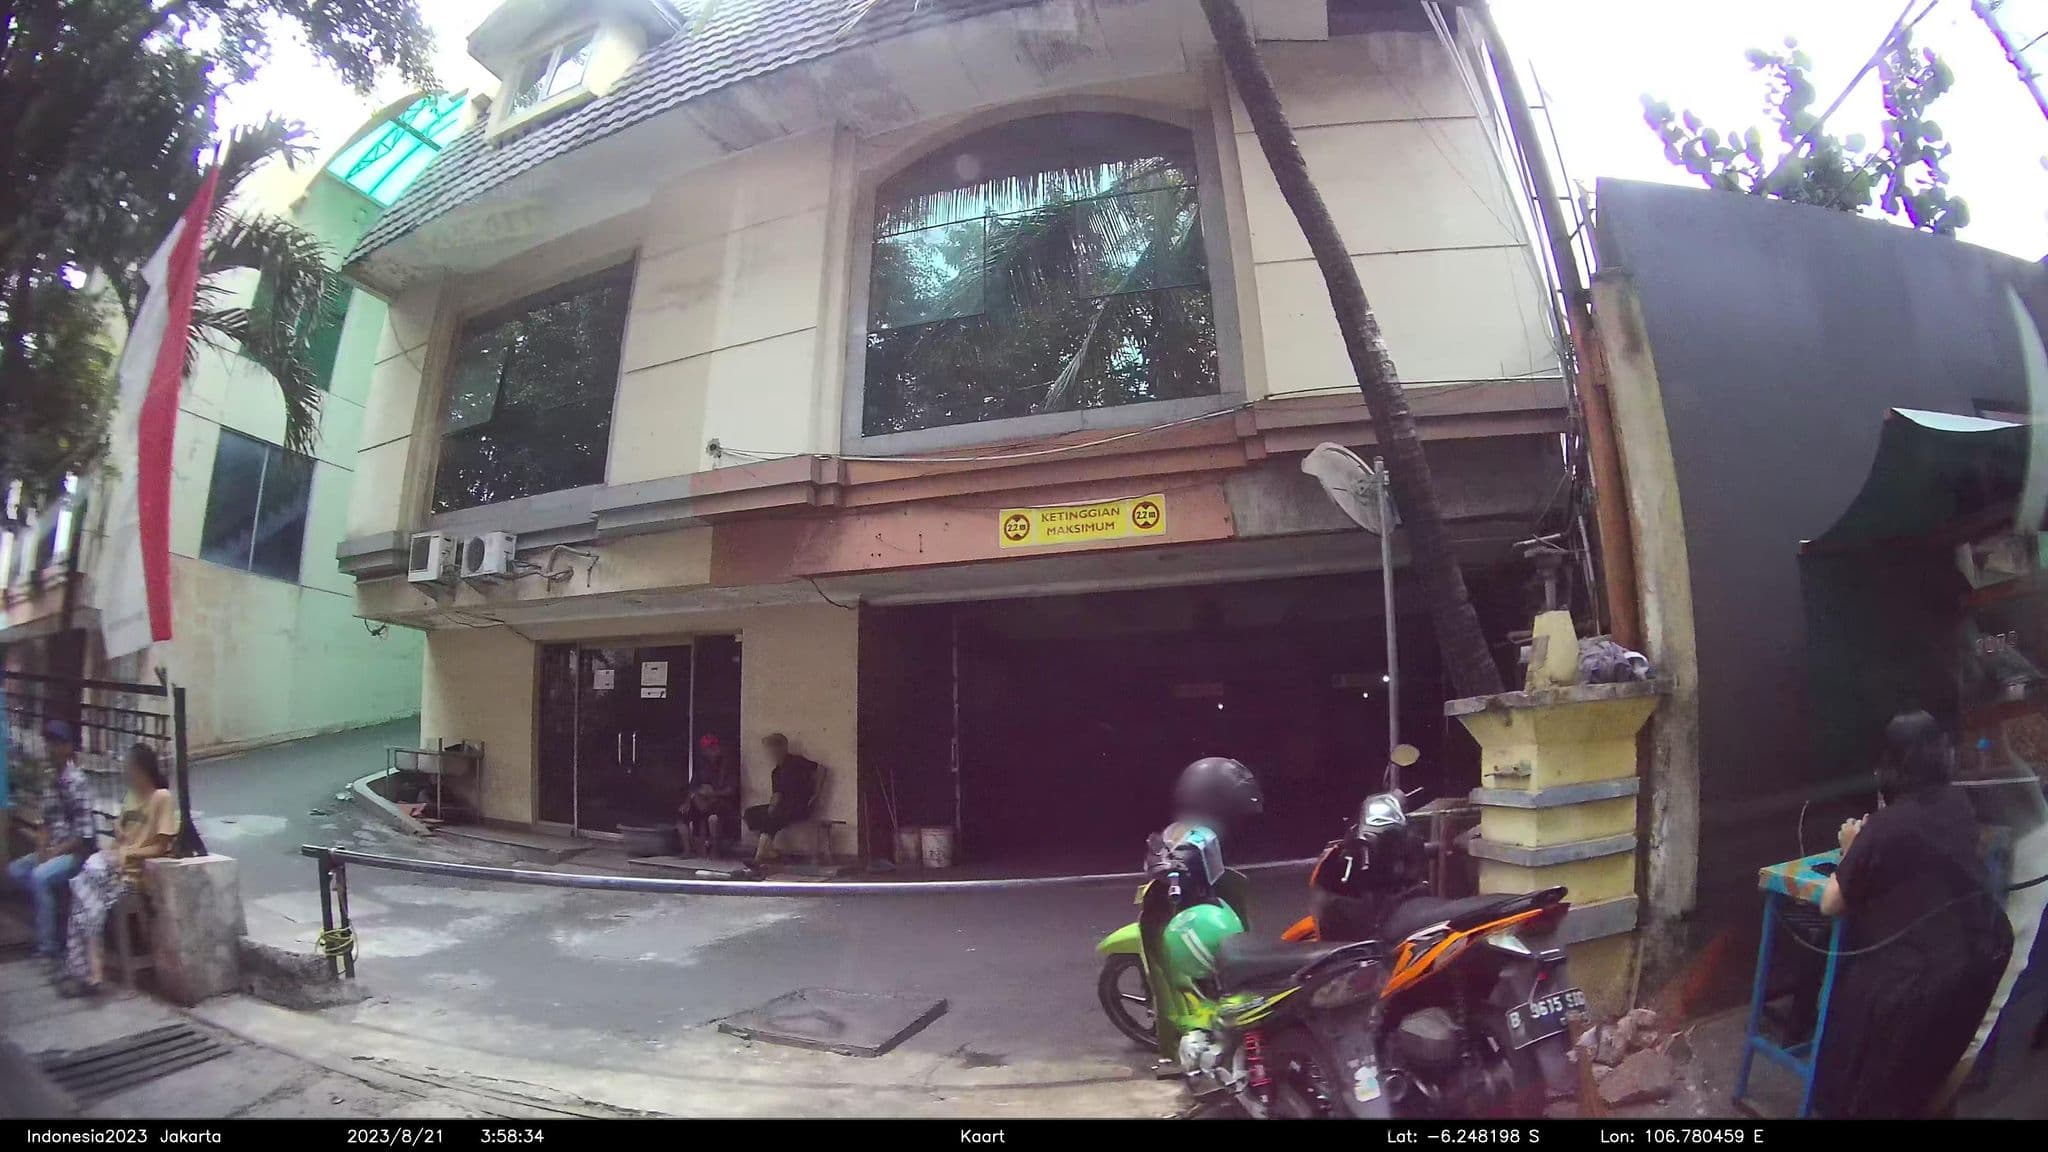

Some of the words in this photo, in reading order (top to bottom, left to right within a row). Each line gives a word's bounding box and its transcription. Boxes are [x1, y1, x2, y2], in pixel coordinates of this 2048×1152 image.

[1041, 507, 1120, 523] KETINGGIAN
[1046, 521, 1115, 536] MAKSIMUM
[1510, 1011, 1521, 1029] B
